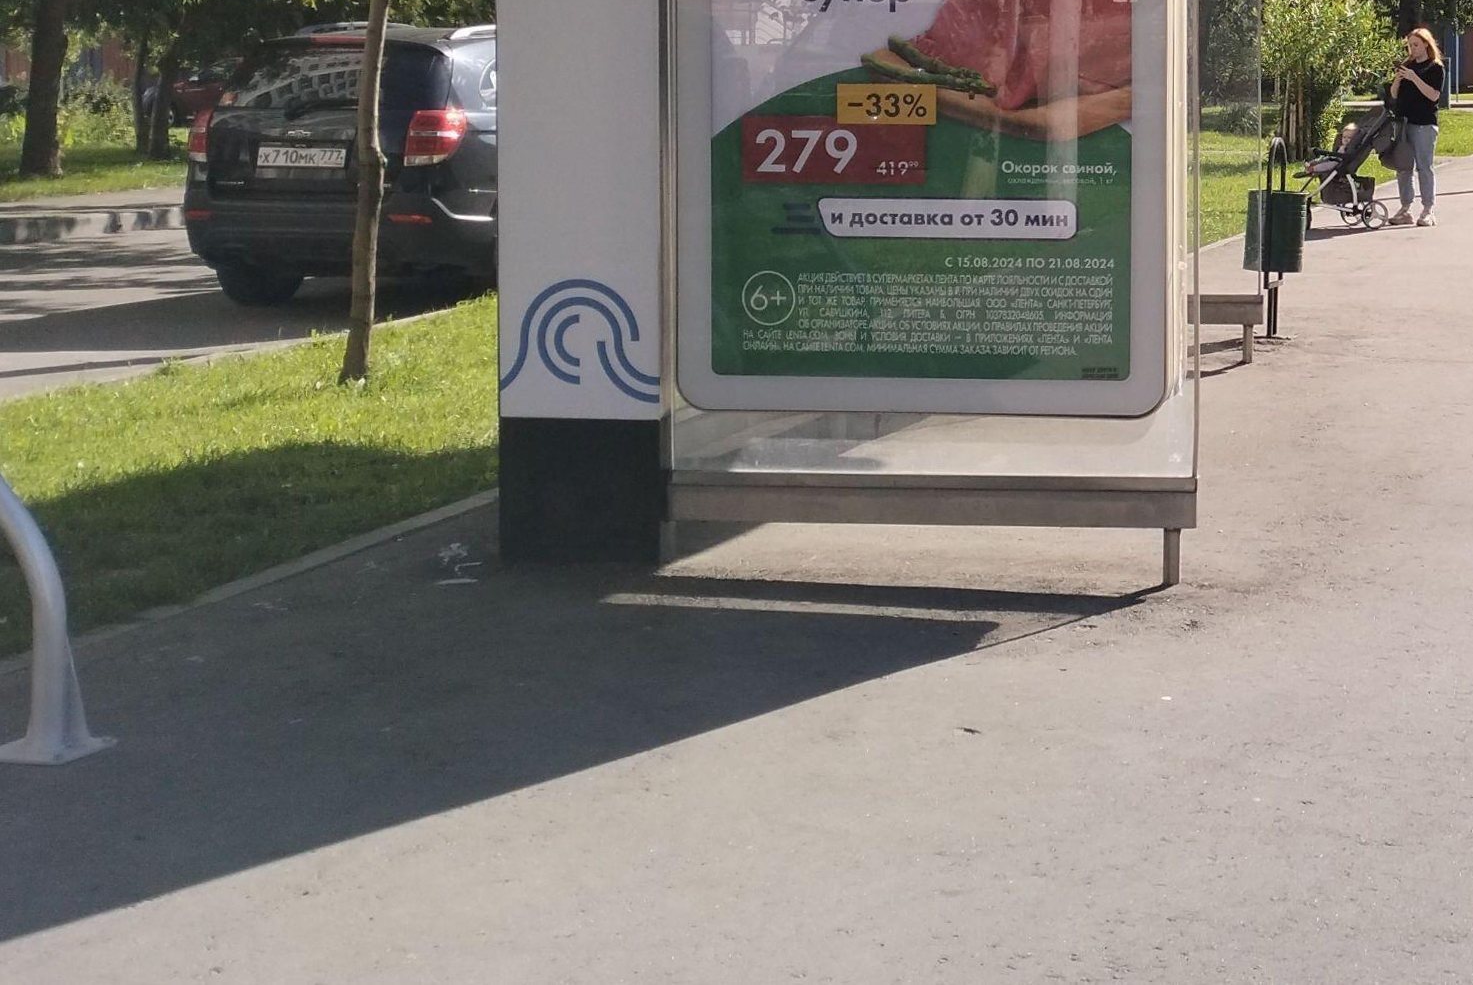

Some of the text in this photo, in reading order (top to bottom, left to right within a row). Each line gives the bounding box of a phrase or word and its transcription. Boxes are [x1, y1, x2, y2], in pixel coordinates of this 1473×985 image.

[755, 128, 858, 174] 279
[1001, 160, 1118, 177] Окорок свиной,
[831, 209, 1068, 228] и доставка от 30 мин
[945, 257, 1115, 269] С 15.08.2024 ПО 21.08.2024
[750, 285, 787, 311] 6+
